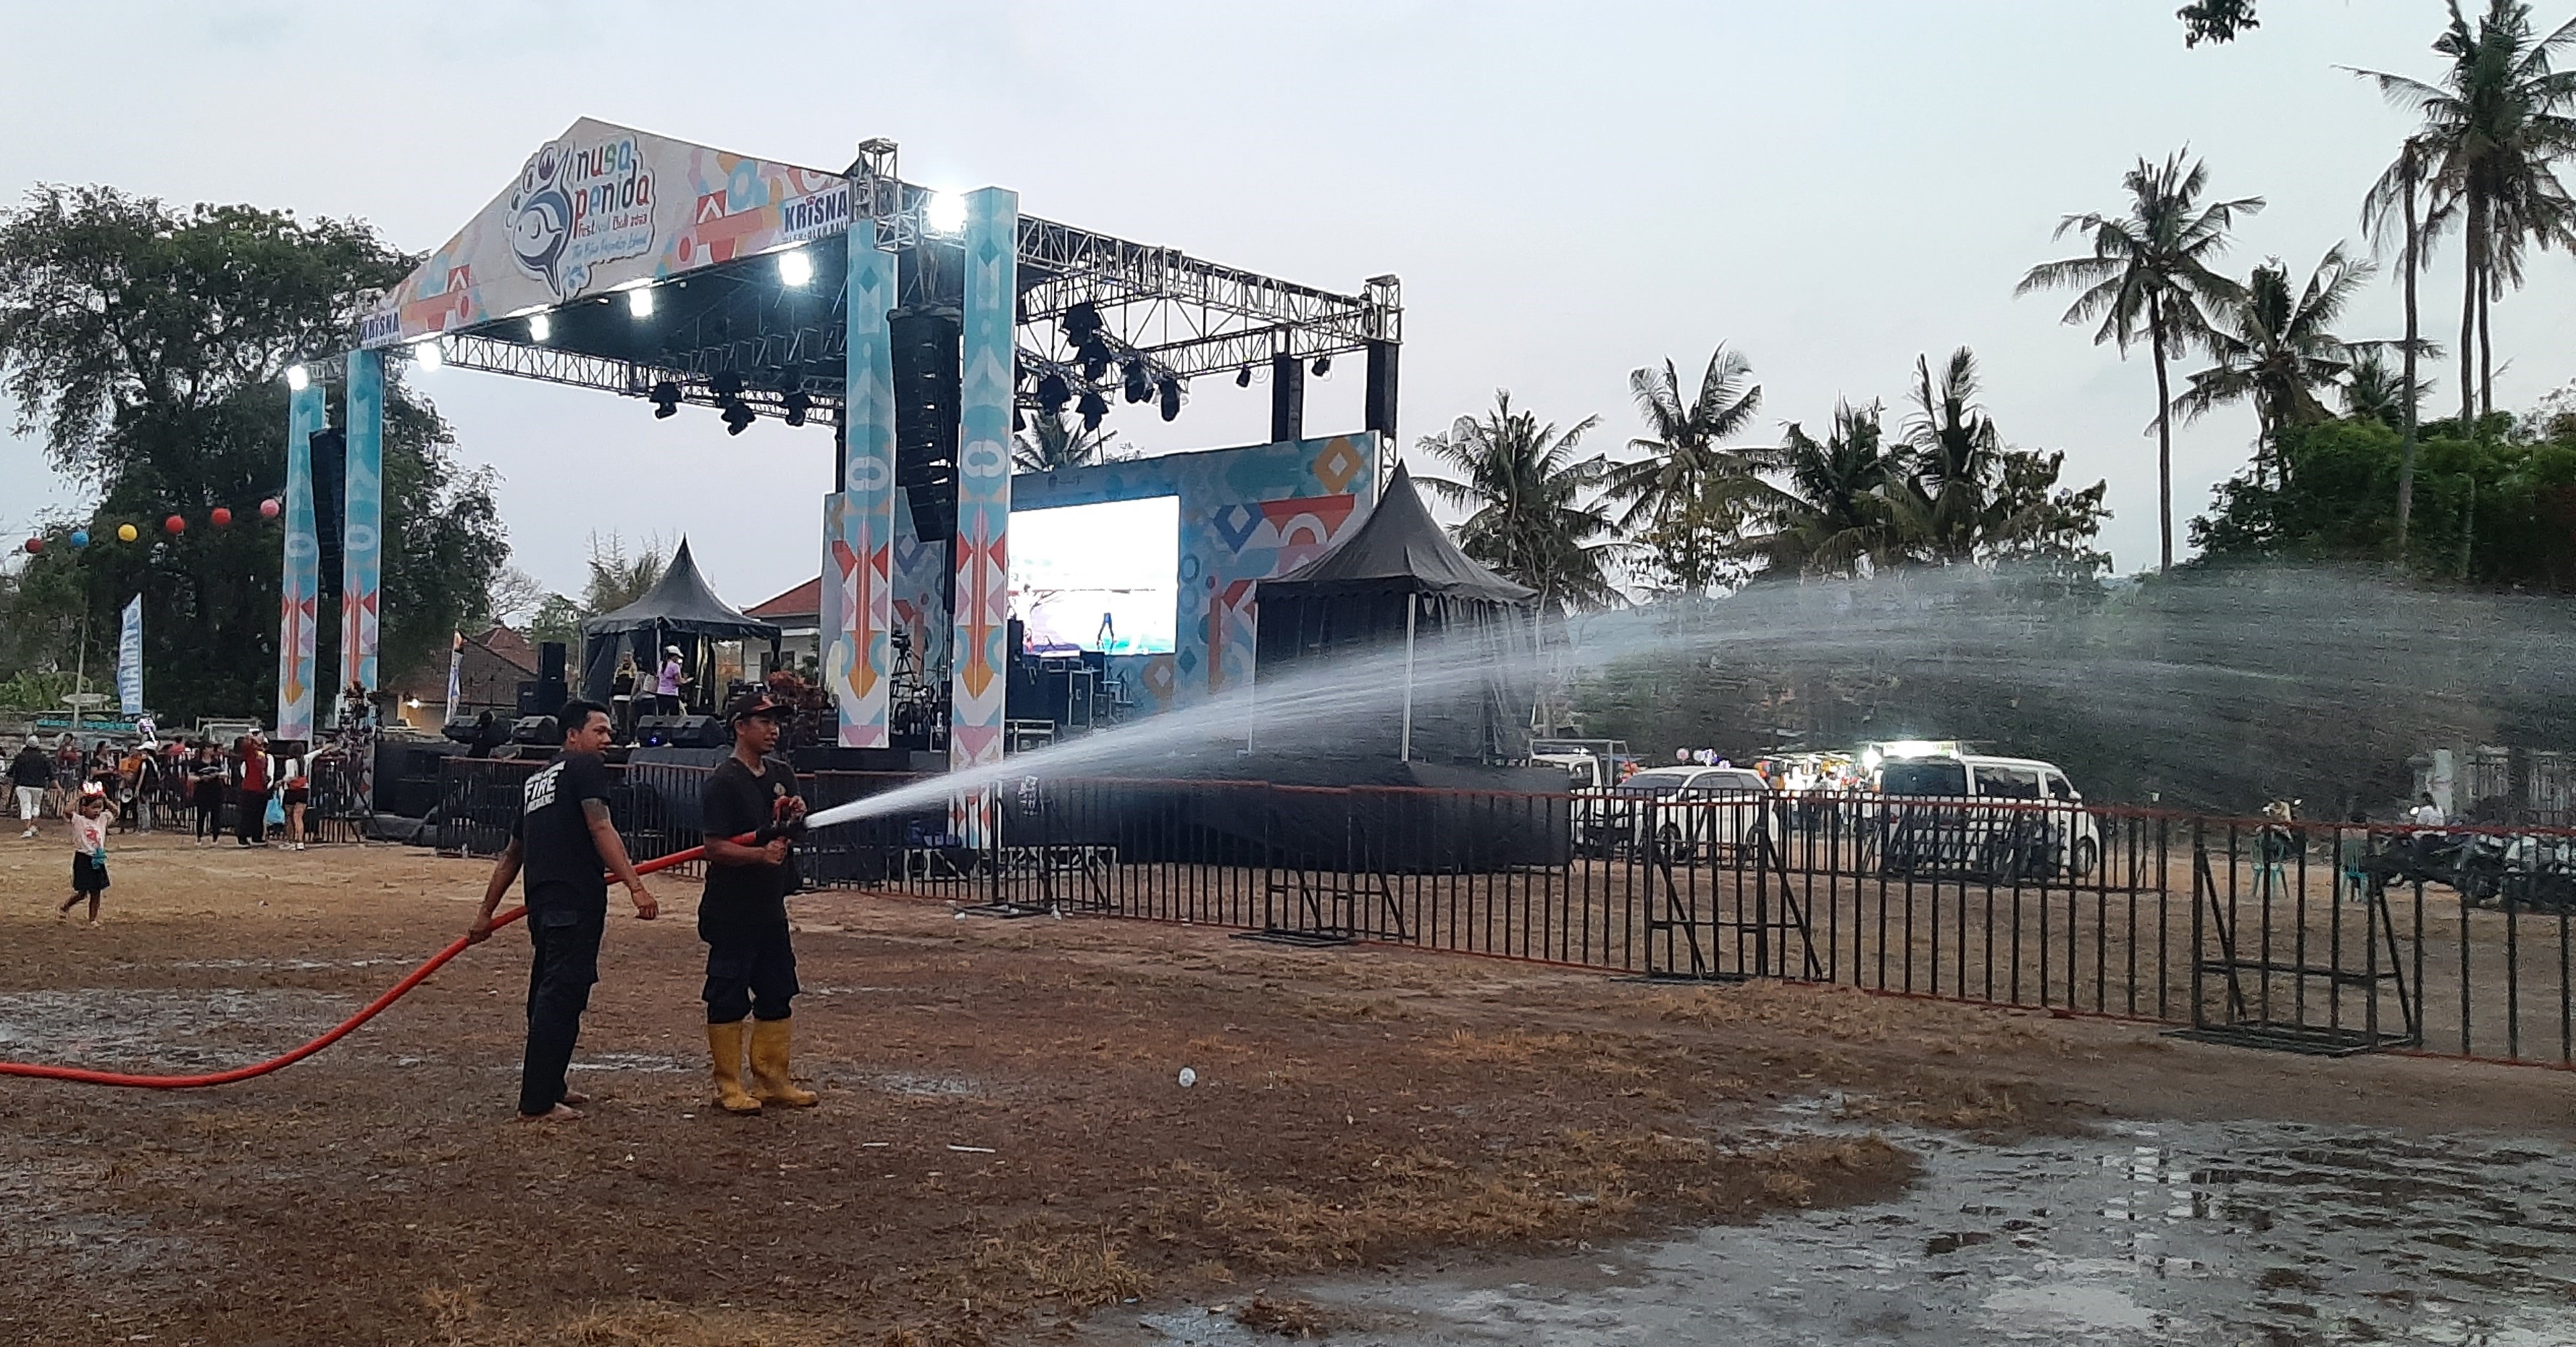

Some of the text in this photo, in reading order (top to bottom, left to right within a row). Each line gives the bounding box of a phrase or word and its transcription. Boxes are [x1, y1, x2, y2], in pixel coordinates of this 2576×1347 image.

[577, 140, 630, 181] nusa
[573, 159, 650, 239] penida
[524, 771, 559, 805] FIRE
